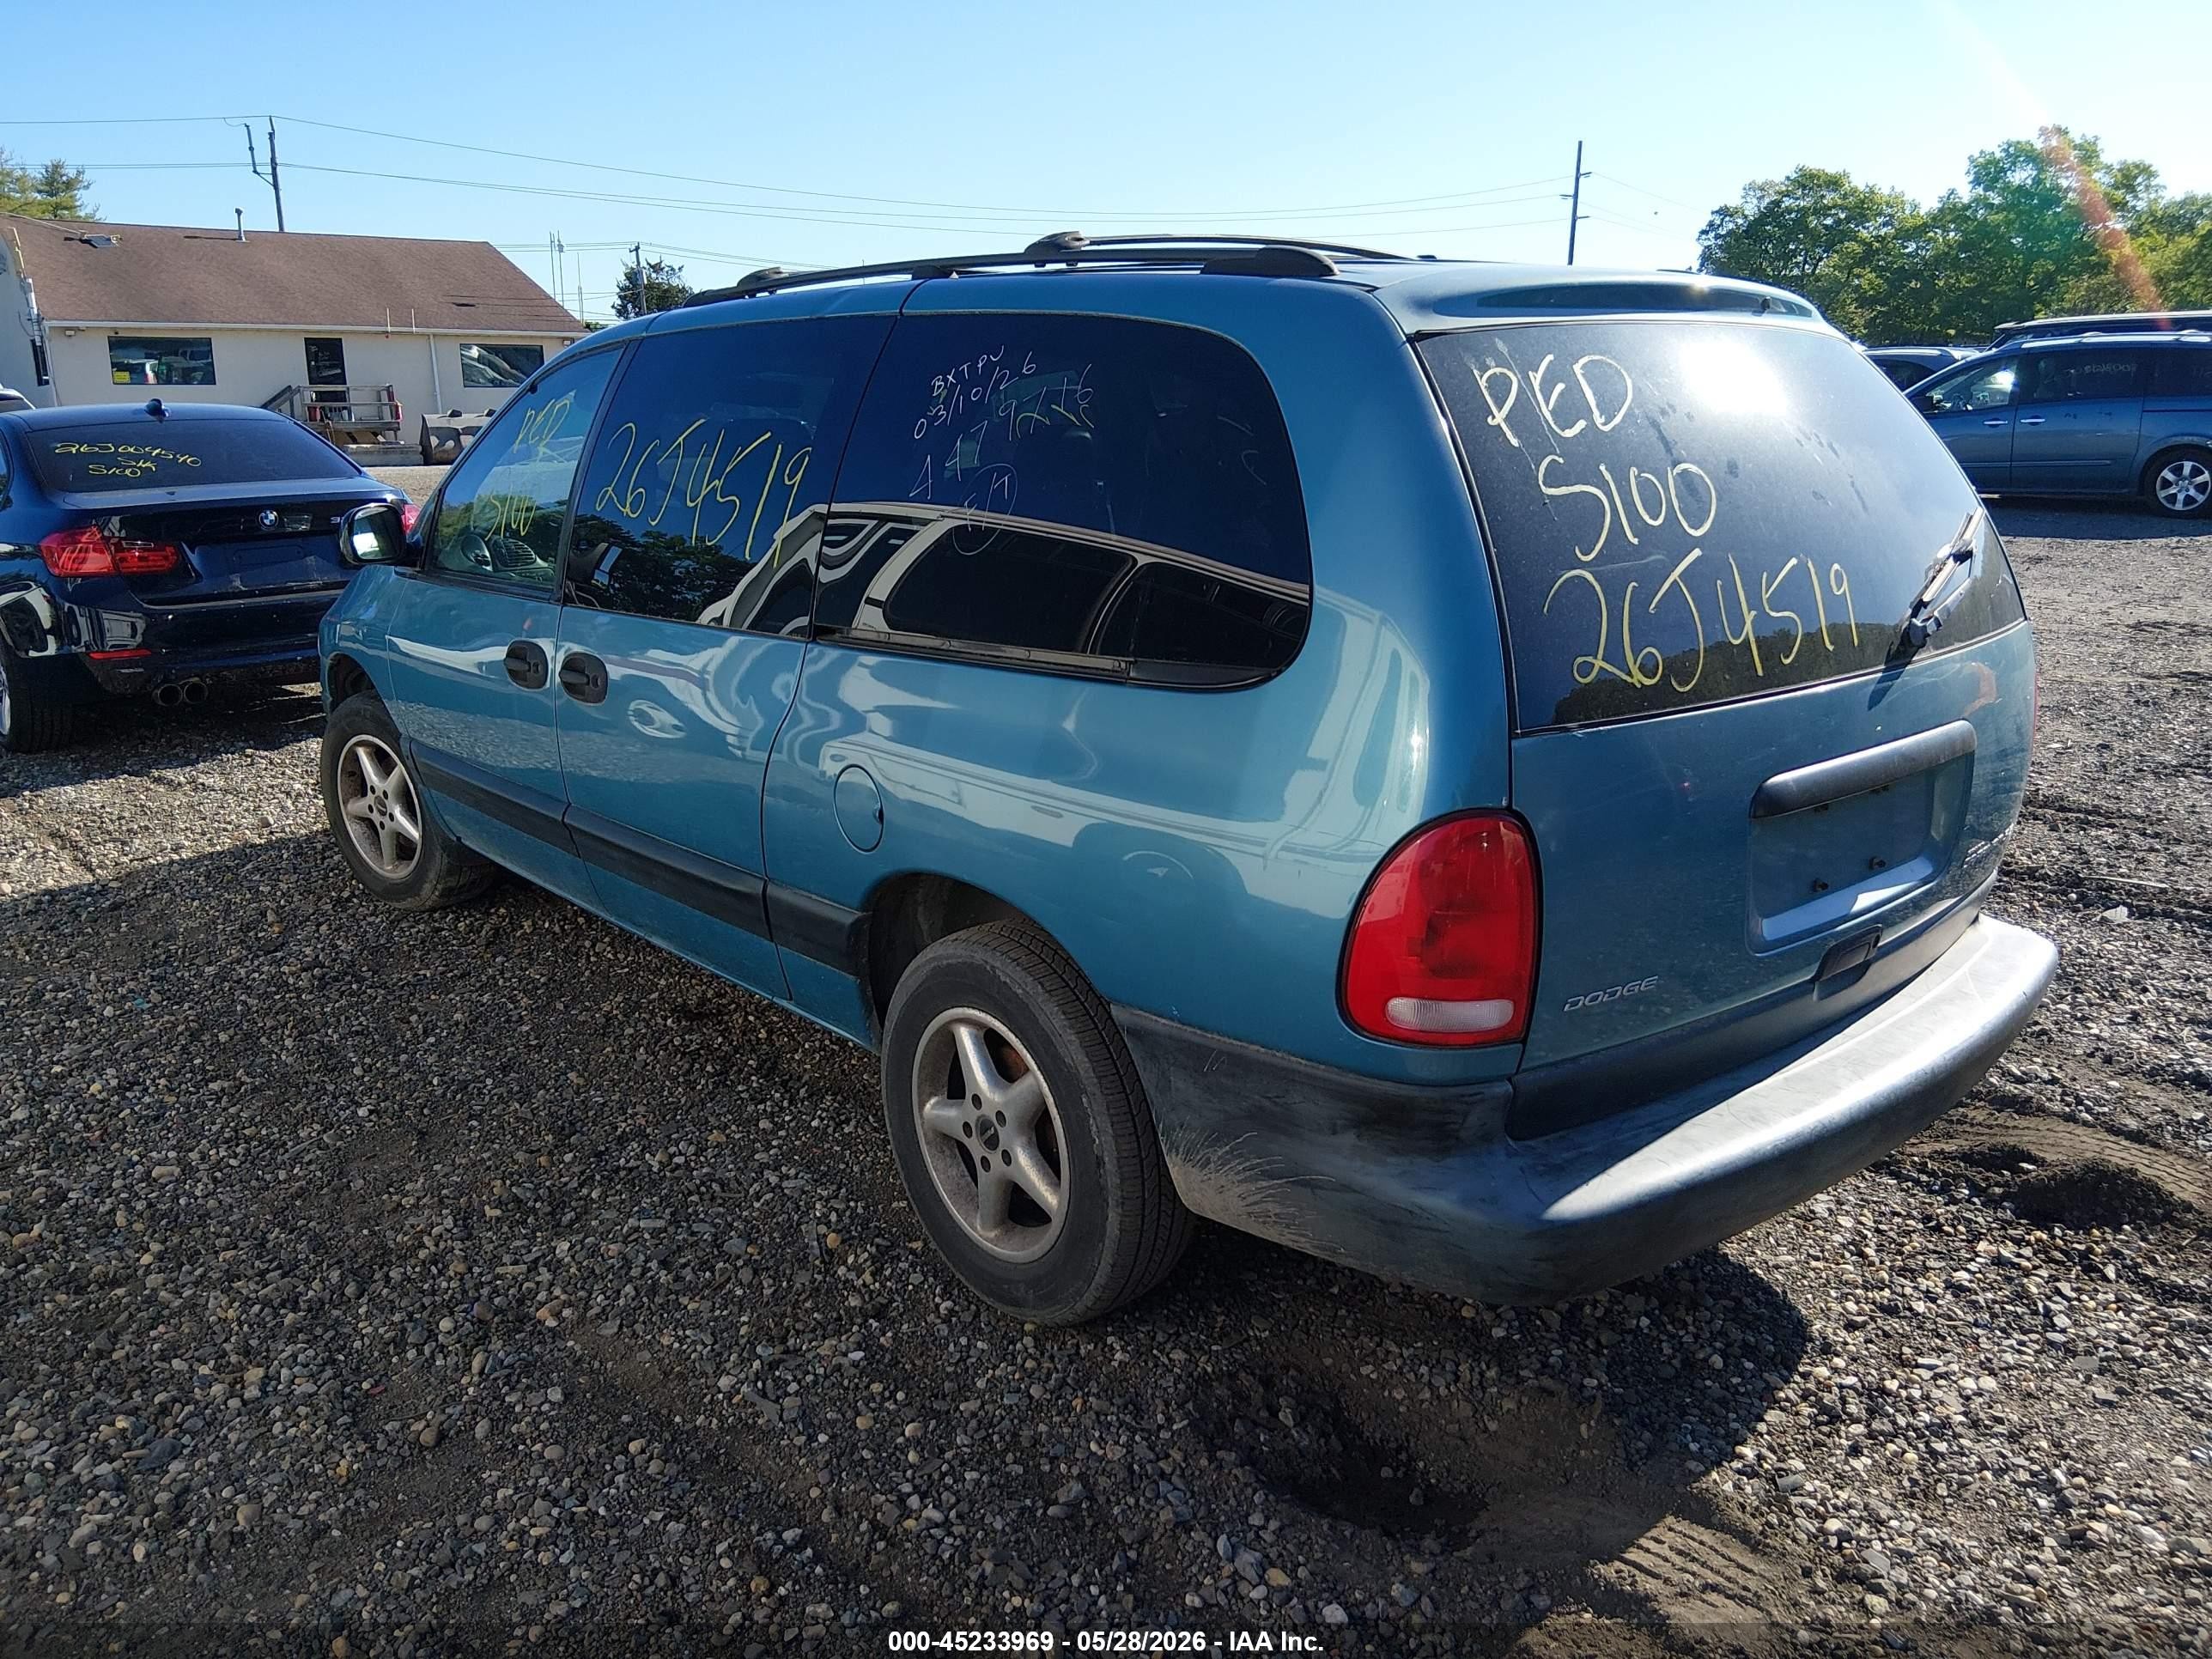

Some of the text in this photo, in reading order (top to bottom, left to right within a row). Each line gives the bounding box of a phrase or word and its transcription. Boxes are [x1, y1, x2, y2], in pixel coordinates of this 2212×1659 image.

[914, 351, 1036, 440] 03/10/26
[1472, 353, 1633, 447] PED
[596, 418, 812, 568] 26J4519
[1537, 454, 1717, 562] S100
[1543, 548, 1860, 693] 26J4519
[1563, 975, 1659, 1012] DODGE
